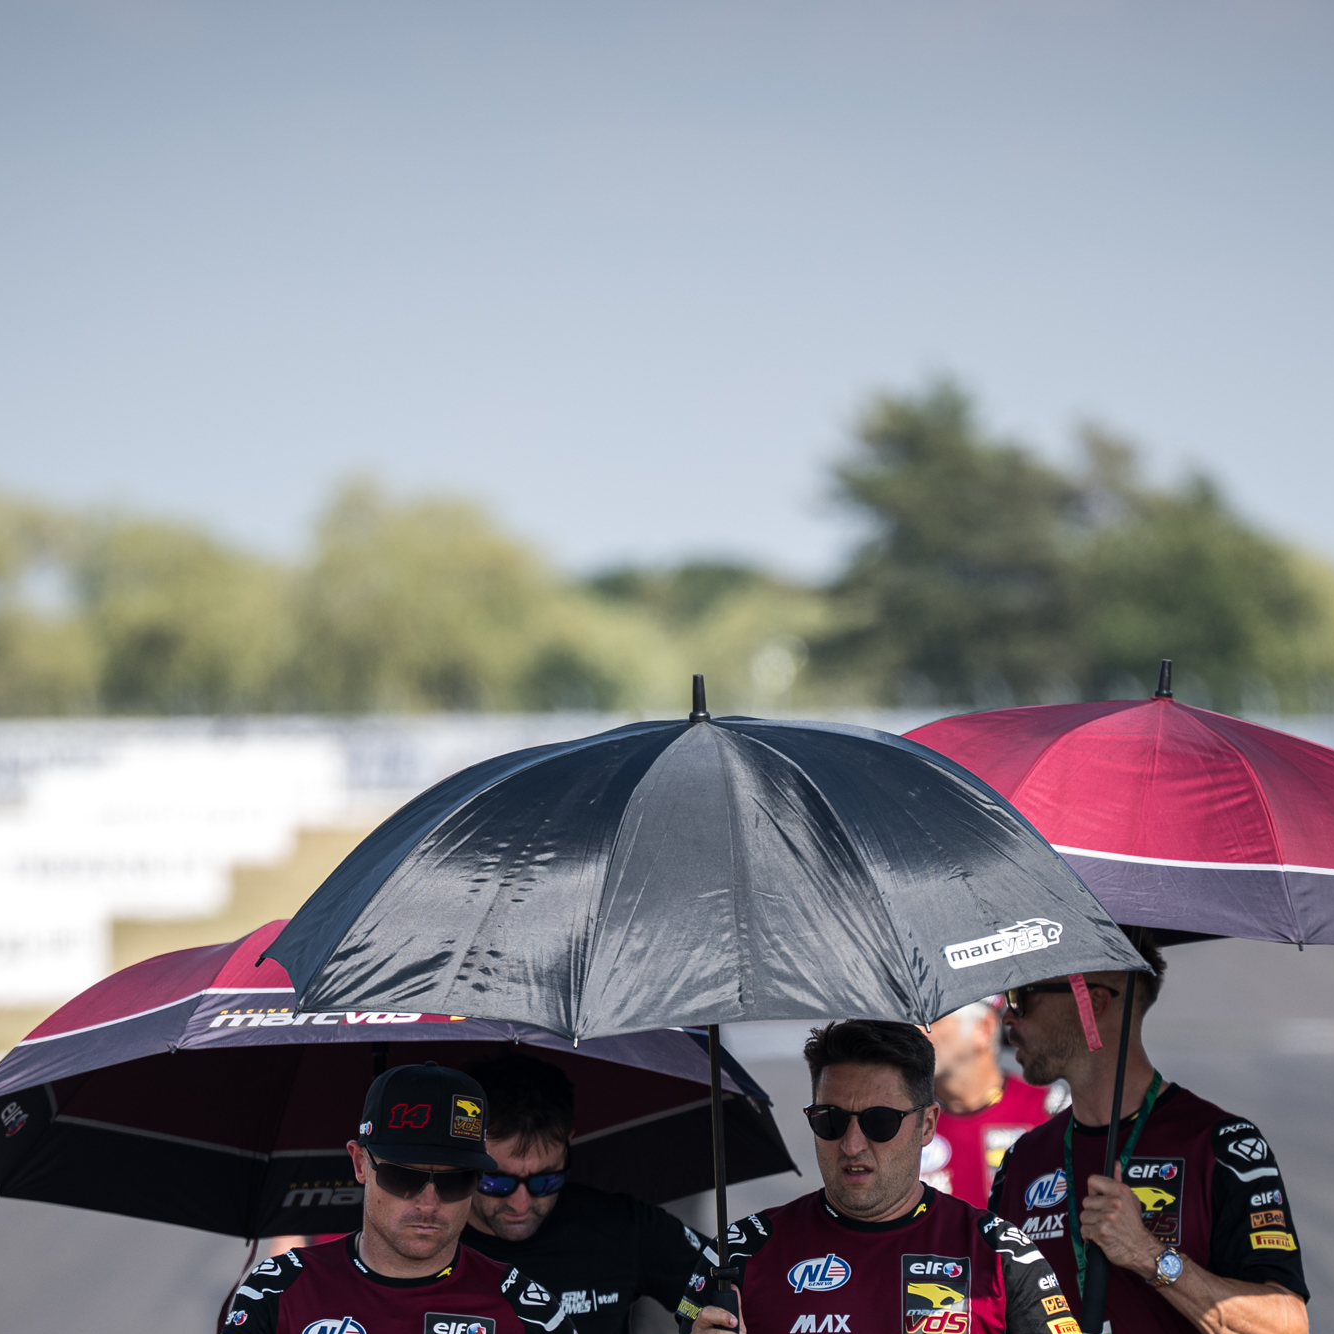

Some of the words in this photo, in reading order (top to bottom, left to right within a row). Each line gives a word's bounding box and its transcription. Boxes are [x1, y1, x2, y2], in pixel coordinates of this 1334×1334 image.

[389, 1103, 431, 1128] 14
[1128, 1164, 1160, 1179] elf
[1251, 1191, 1273, 1206] elf
[1022, 1213, 1065, 1233] MAX
[909, 1261, 943, 1275] elf
[906, 1308, 943, 1316] marc
[790, 1314, 851, 1334] MAX
[906, 1311, 968, 1334] vds
